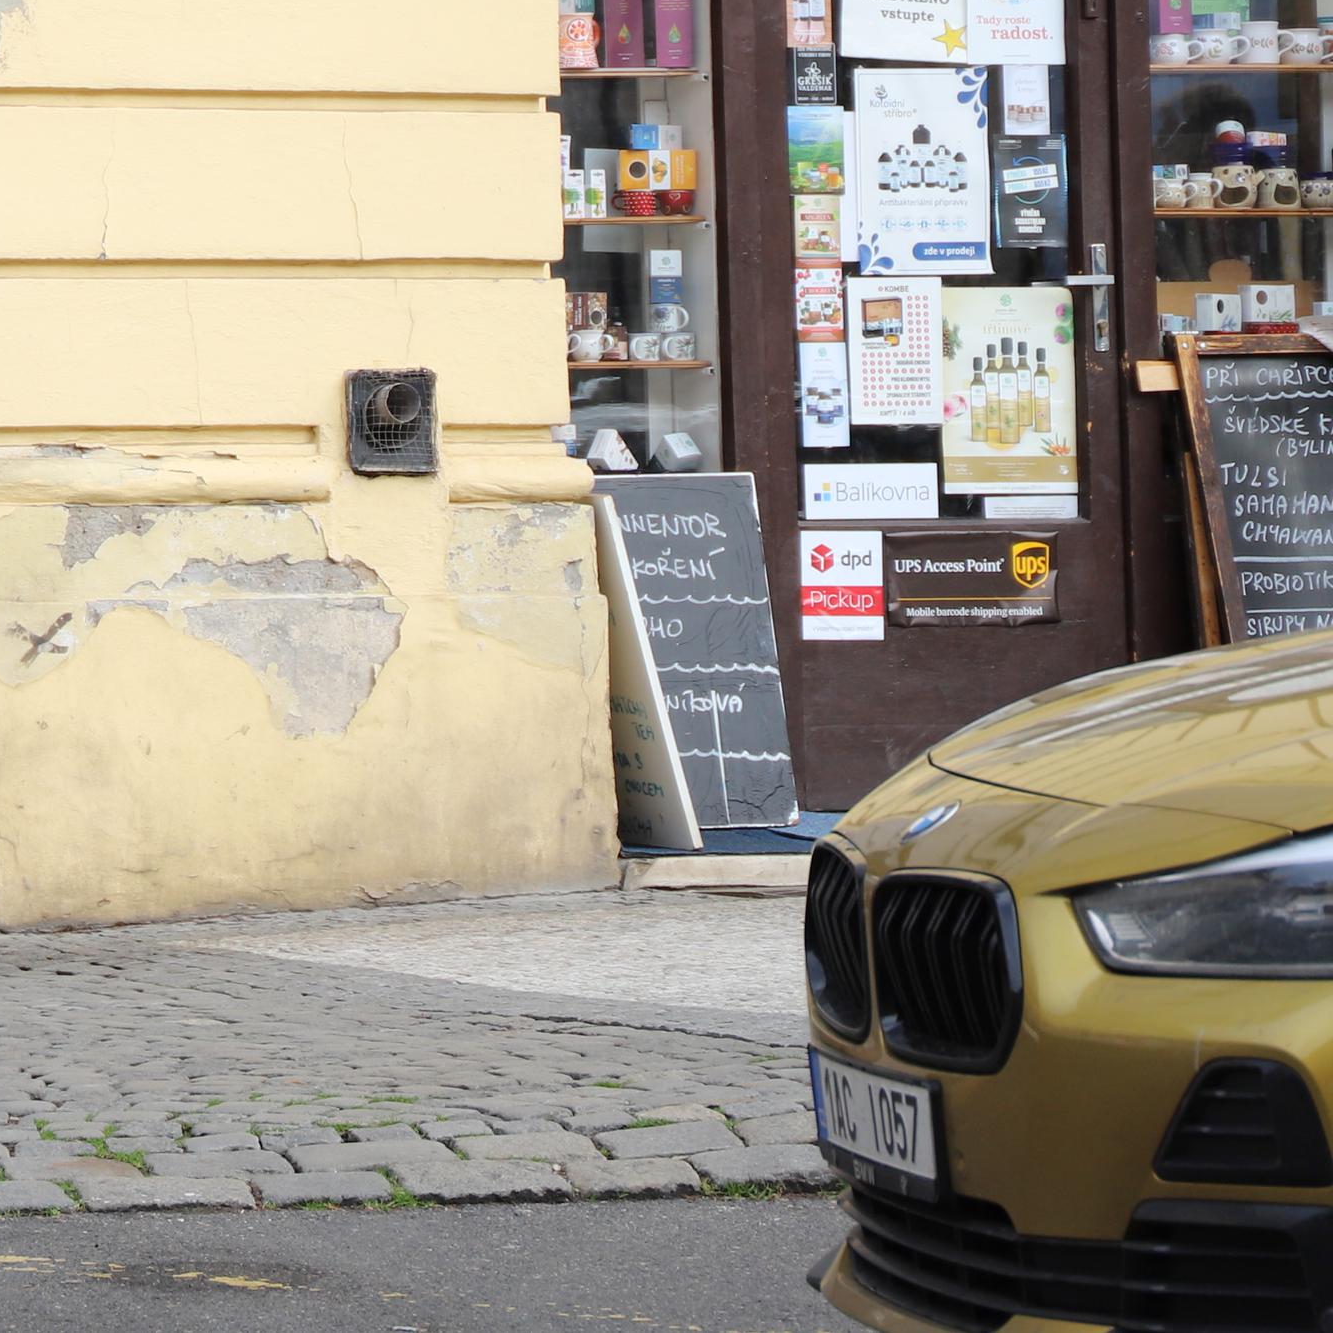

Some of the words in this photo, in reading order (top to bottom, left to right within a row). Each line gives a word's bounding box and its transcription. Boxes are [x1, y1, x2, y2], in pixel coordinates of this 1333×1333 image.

[880, 9, 935, 23] vstupte
[976, 15, 1002, 25] Tady
[1004, 17, 1031, 25] roste
[991, 26, 1054, 40] radost.
[924, 247, 938, 255] zde
[946, 246, 975, 257] prodeji
[1205, 362, 1239, 389] PŘI
[1224, 405, 1310, 435] ŠVÉDSKÉ
[1319, 413, 1333, 435] K
[1275, 436, 1333, 458] (BYLIN
[1220, 462, 1287, 488] TULSI
[835, 481, 930, 502] Balíkovna
[1242, 520, 1333, 547] CHYAWAN
[632, 547, 726, 581] KOŘENÍ
[840, 550, 872, 570] dpd
[894, 559, 922, 573] UPS
[923, 559, 965, 573] Access
[1016, 555, 1046, 582] ups
[1241, 570, 1333, 596] PROBIOTIK
[810, 590, 875, 612] Pickup
[906, 607, 935, 617] Mobile
[936, 607, 970, 617] barcode
[970, 606, 1008, 619] shipping
[1008, 606, 1043, 617] enabled
[1246, 614, 1306, 637] SIRUPY
[1316, 613, 1333, 630] N
[824, 1067, 858, 1142] 1AC
[868, 1083, 919, 1163] 1057
